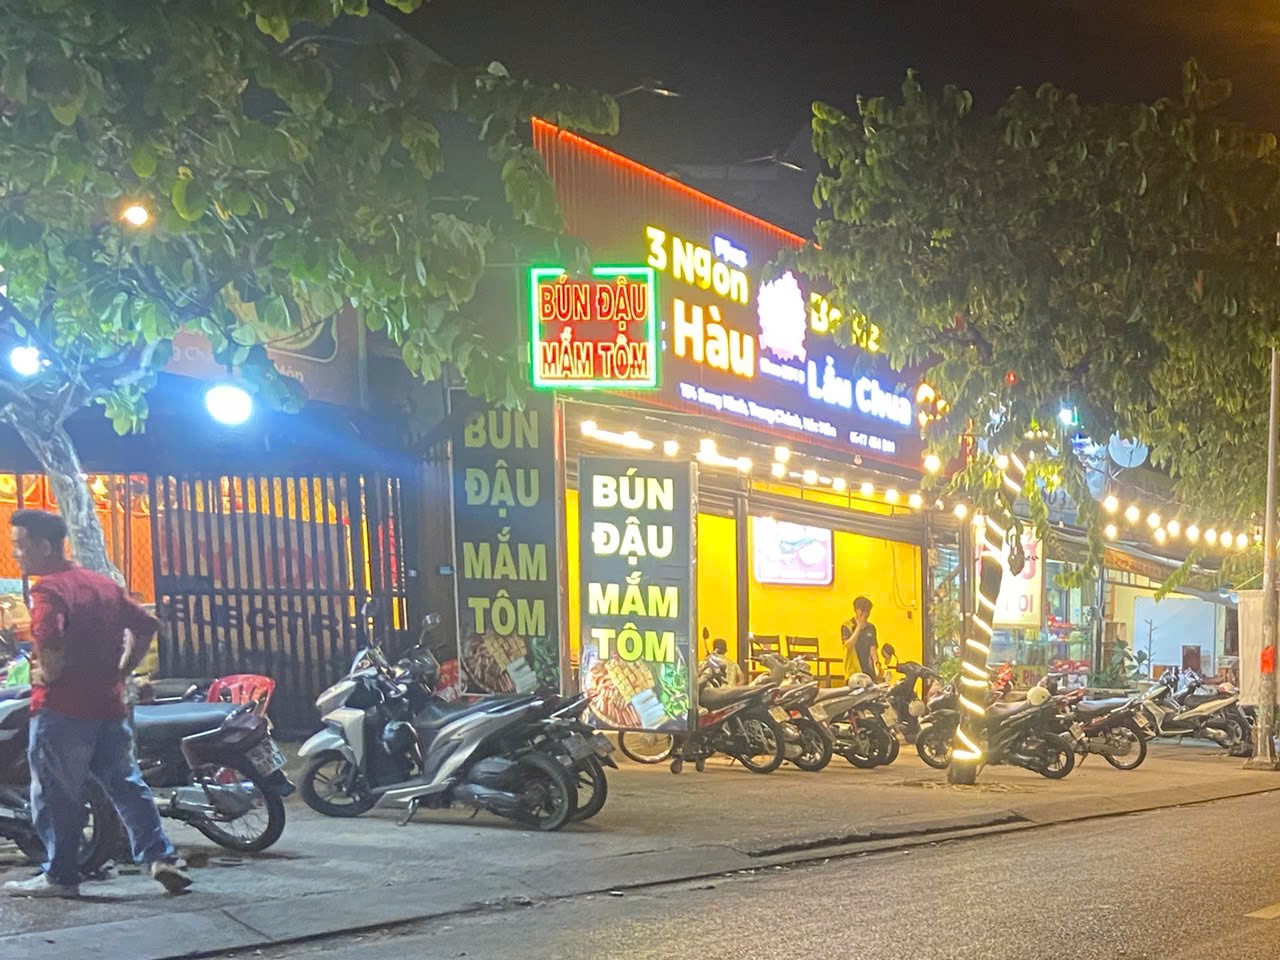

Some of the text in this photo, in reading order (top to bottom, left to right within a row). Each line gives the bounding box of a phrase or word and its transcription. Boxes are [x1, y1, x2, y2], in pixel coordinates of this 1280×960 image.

[646, 225, 667, 271] 3
[672, 236, 749, 305] Ngon
[540, 273, 648, 332] BÚN ĐẬU
[540, 326, 649, 379] MẮM TÔM
[673, 298, 755, 378] Hàu
[465, 458, 540, 518] ĐẬU
[592, 466, 674, 511] BÚN
[463, 526, 548, 581] MẮM
[591, 515, 674, 566] ĐẬU
[467, 588, 546, 637] TÔM
[587, 570, 679, 618] MẮM
[591, 622, 675, 663] TÔM
